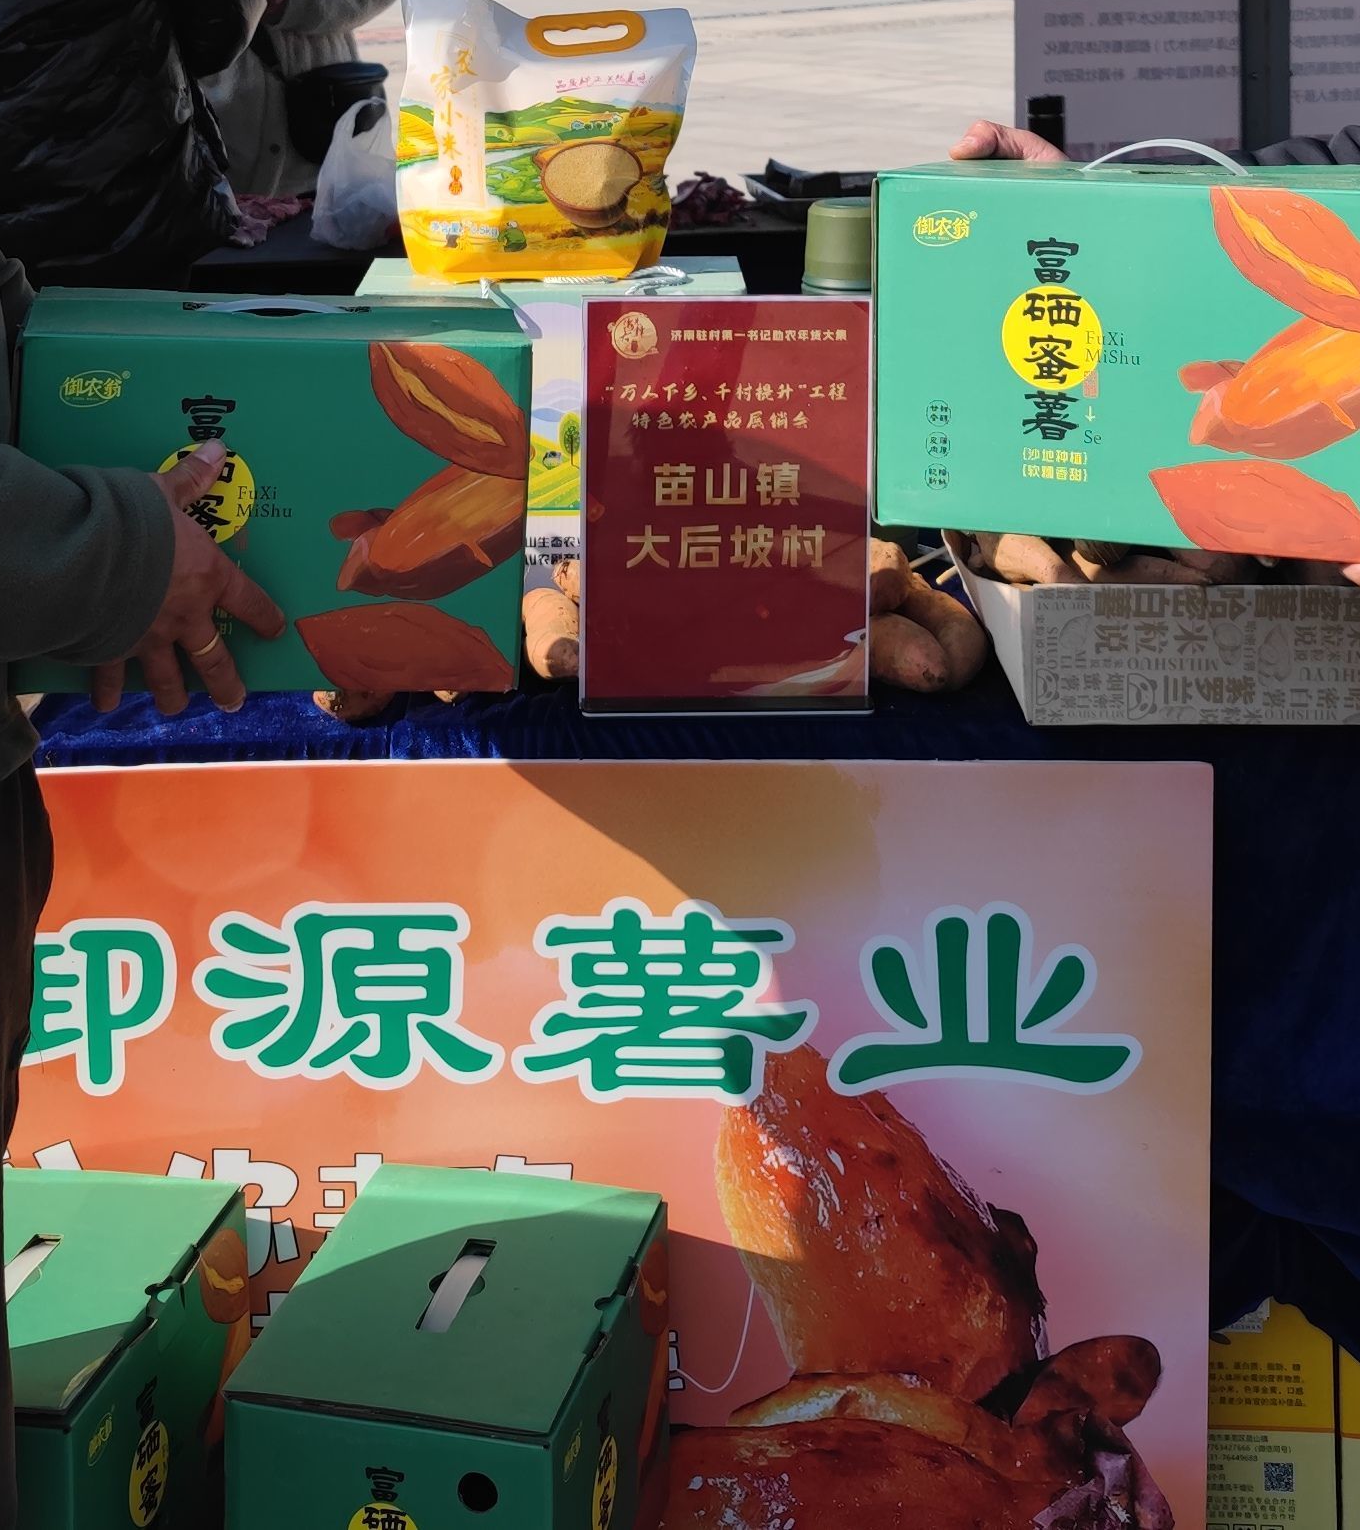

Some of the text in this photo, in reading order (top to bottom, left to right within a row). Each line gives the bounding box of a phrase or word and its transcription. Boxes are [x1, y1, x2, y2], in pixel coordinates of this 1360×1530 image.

[670, 328, 848, 342] 济南驻村第一书记助农年货大集
[1021, 236, 1083, 442] 富硒蜜薯
[1085, 330, 1125, 347] FuXi
[1085, 347, 1141, 366] MiShu
[631, 410, 810, 430] 特色农产品展销会
[1083, 430, 1102, 445] Se
[237, 485, 277, 500] FuXi
[653, 462, 801, 507] 苗山镇
[235, 503, 292, 518] MiShu
[626, 523, 826, 569] 大后坡村
